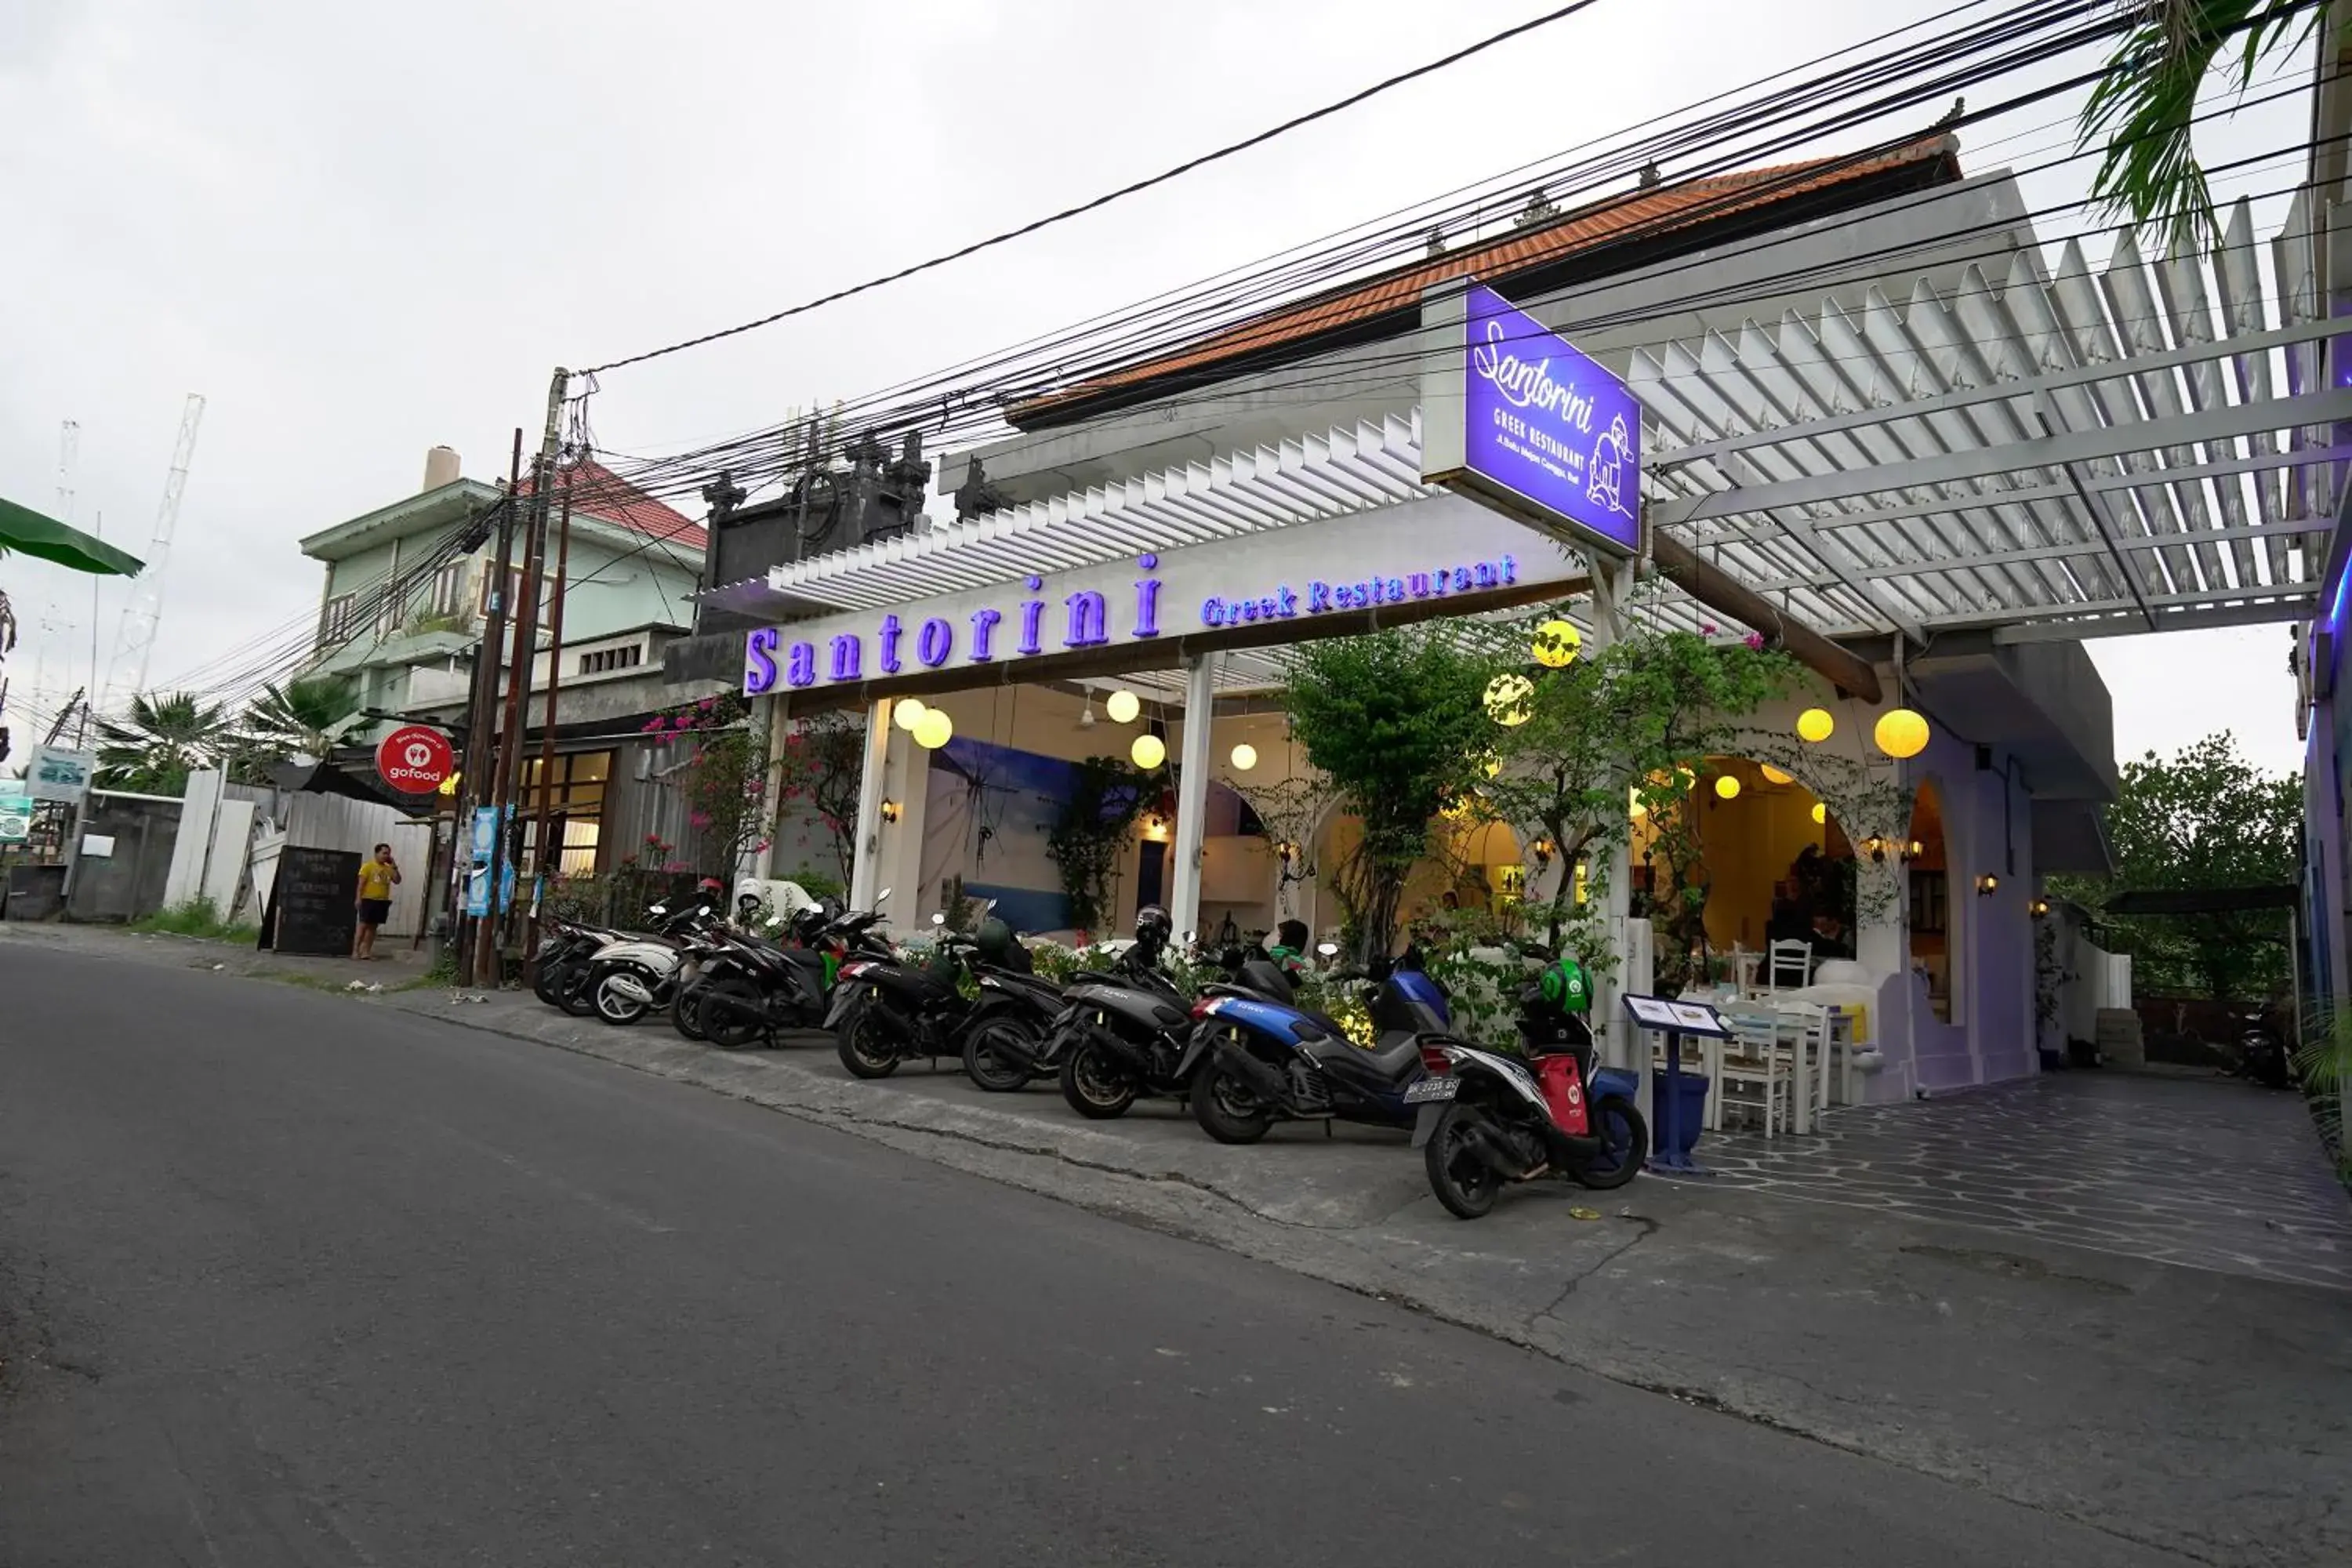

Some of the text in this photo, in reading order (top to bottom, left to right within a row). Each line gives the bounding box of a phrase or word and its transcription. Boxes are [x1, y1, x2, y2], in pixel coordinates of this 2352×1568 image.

[1474, 321, 1594, 434] Santorini
[1493, 408, 1584, 472] GREEK RESTAURANT
[746, 552, 1163, 694] Santorini
[1200, 552, 1519, 627] Greek Restaurant
[390, 767, 441, 782] gofood
